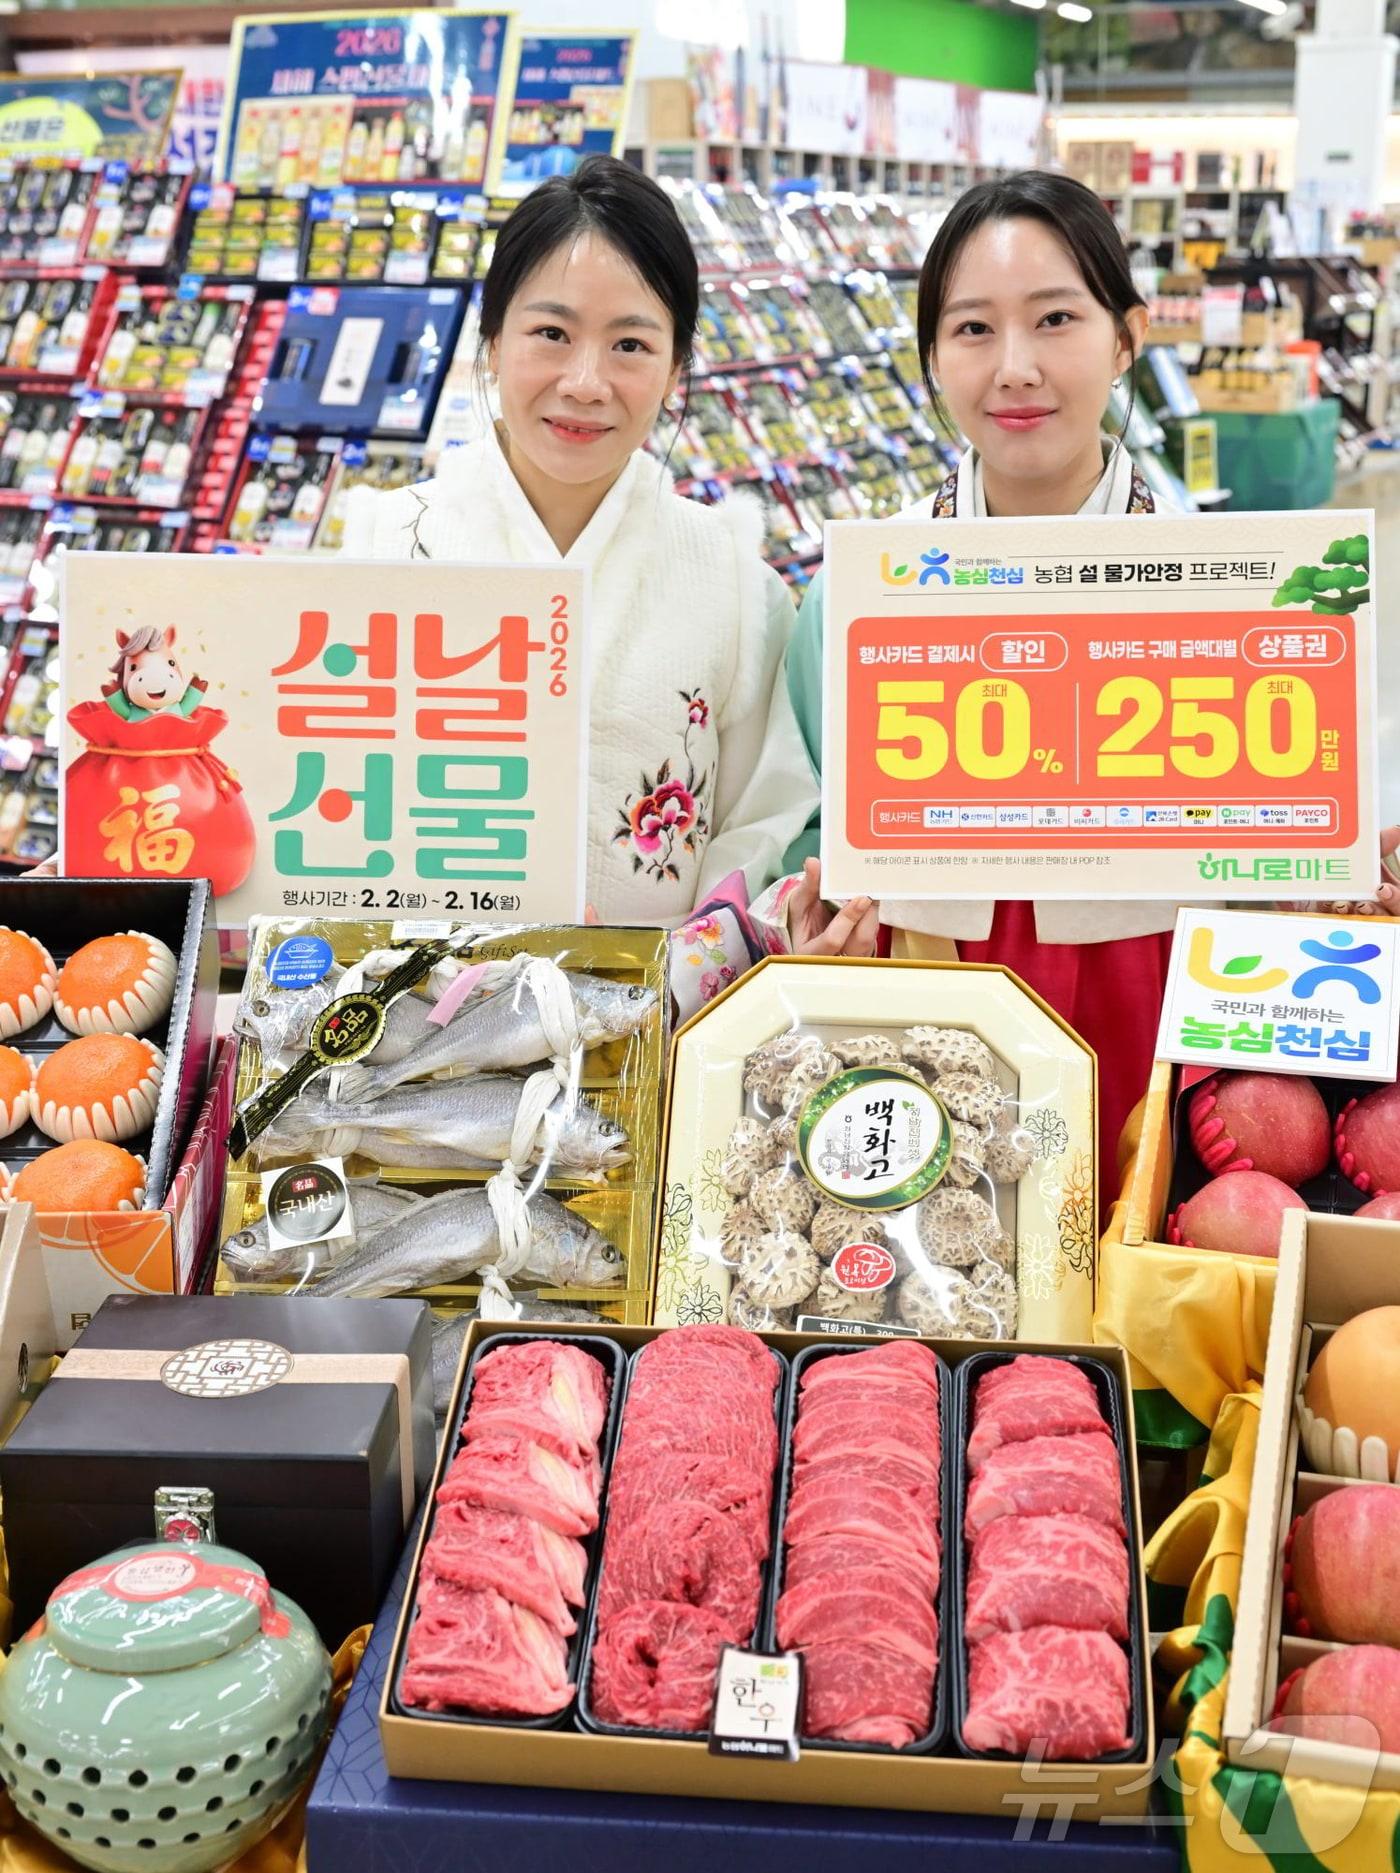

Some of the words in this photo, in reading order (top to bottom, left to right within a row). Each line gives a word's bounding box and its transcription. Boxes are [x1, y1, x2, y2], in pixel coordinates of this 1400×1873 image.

[953, 567, 1024, 586] 농심천심
[1034, 564, 1073, 584] 농협
[1079, 564, 1098, 583] 설
[1104, 563, 1182, 583] 물가안정
[1189, 561, 1276, 581] 프로젝트!
[548, 595, 569, 697] 2026
[860, 646, 924, 664] 행사카드
[927, 645, 975, 664] 결제시
[1001, 640, 1045, 664] 할인
[1088, 641, 1145, 660] 행사카드
[1148, 641, 1177, 659] 구매
[1180, 639, 1237, 659] 금액대별
[1258, 634, 1328, 659] 상품권
[271, 611, 547, 742] 설날
[1267, 680, 1293, 694] 최대
[982, 684, 1007, 698] 최대
[1096, 674, 1317, 778] 250
[268, 752, 536, 881] 선물
[879, 812, 921, 823] 행사카드
[930, 809, 953, 819] NH
[999, 812, 1029, 822] 삼성카드
[1195, 808, 1212, 818] pay
[1270, 809, 1288, 817] toss
[1295, 809, 1328, 817] PAYCO
[99, 783, 196, 874] 福
[1079, 856, 1095, 865] POP
[1197, 852, 1352, 881] 하나로마트
[282, 889, 348, 907] 행사기간
[1211, 999, 1267, 1017] 국민과
[1270, 1004, 1346, 1024] 함께하는
[1180, 1016, 1371, 1062] 농심천심
[863, 1098, 896, 1181] 백화고
[279, 1190, 336, 1218] 국내산
[729, 1678, 783, 1733] 한우
